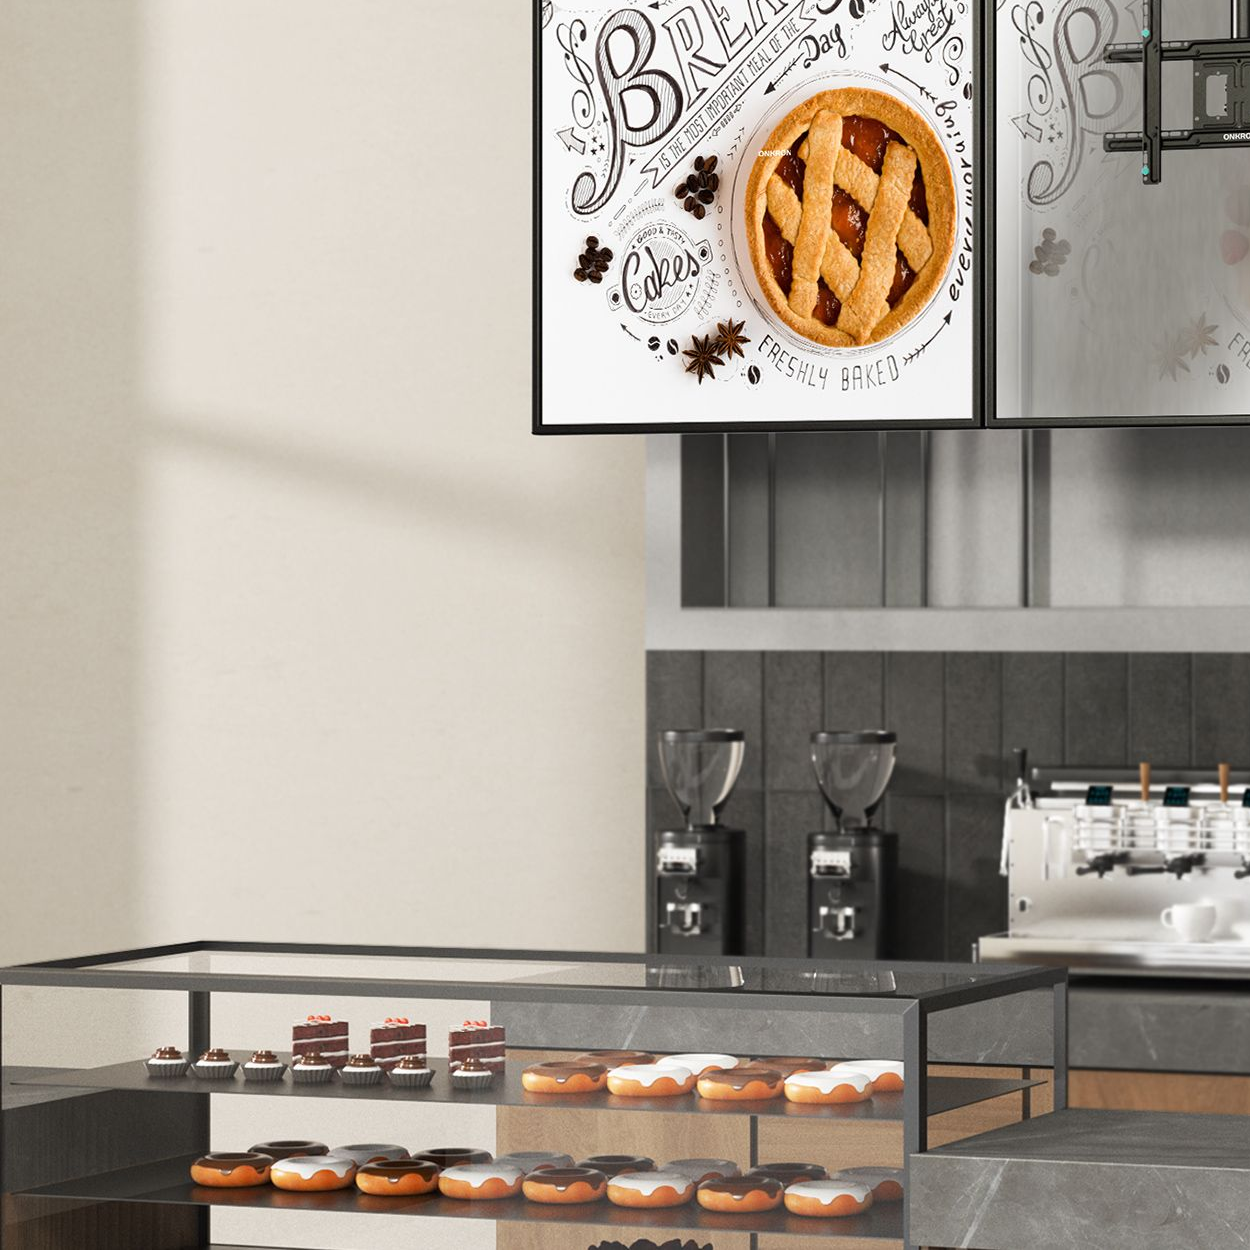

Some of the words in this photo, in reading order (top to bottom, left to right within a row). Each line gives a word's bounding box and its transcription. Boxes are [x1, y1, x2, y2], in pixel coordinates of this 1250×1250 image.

[798, 23, 847, 70] Day
[659, 154, 672, 171] IS
[668, 137, 685, 162] THE
[683, 115, 708, 145] MOST
[705, 71, 750, 122] IMPORTANT
[749, 51, 773, 77] MEAL
[769, 33, 783, 54] OF
[781, 16, 801, 41] THE
[758, 149, 792, 158] ONKRON
[636, 227, 658, 244] GOOD
[666, 228, 686, 245] TASTY
[622, 245, 701, 314] Cakes
[647, 310, 671, 320] EVERY
[757, 334, 829, 391] FRESHLY
[841, 354, 900, 392] BAKED
